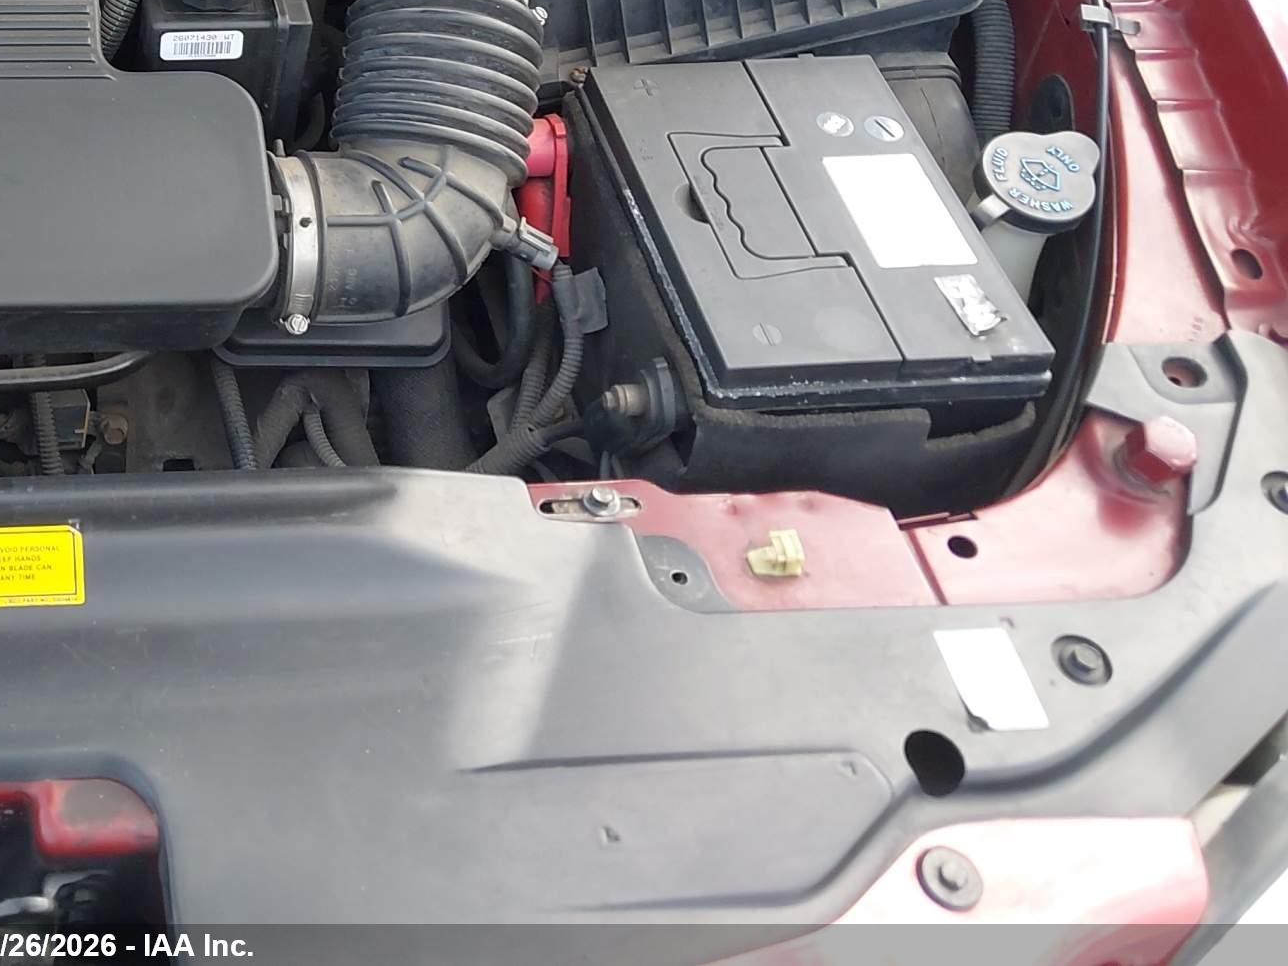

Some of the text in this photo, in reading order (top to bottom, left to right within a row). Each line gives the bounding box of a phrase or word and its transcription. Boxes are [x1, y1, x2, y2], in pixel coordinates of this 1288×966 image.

[992, 147, 1008, 182] FLUID
[1046, 146, 1080, 173] ONLY
[1008, 188, 1074, 212] WASHER
